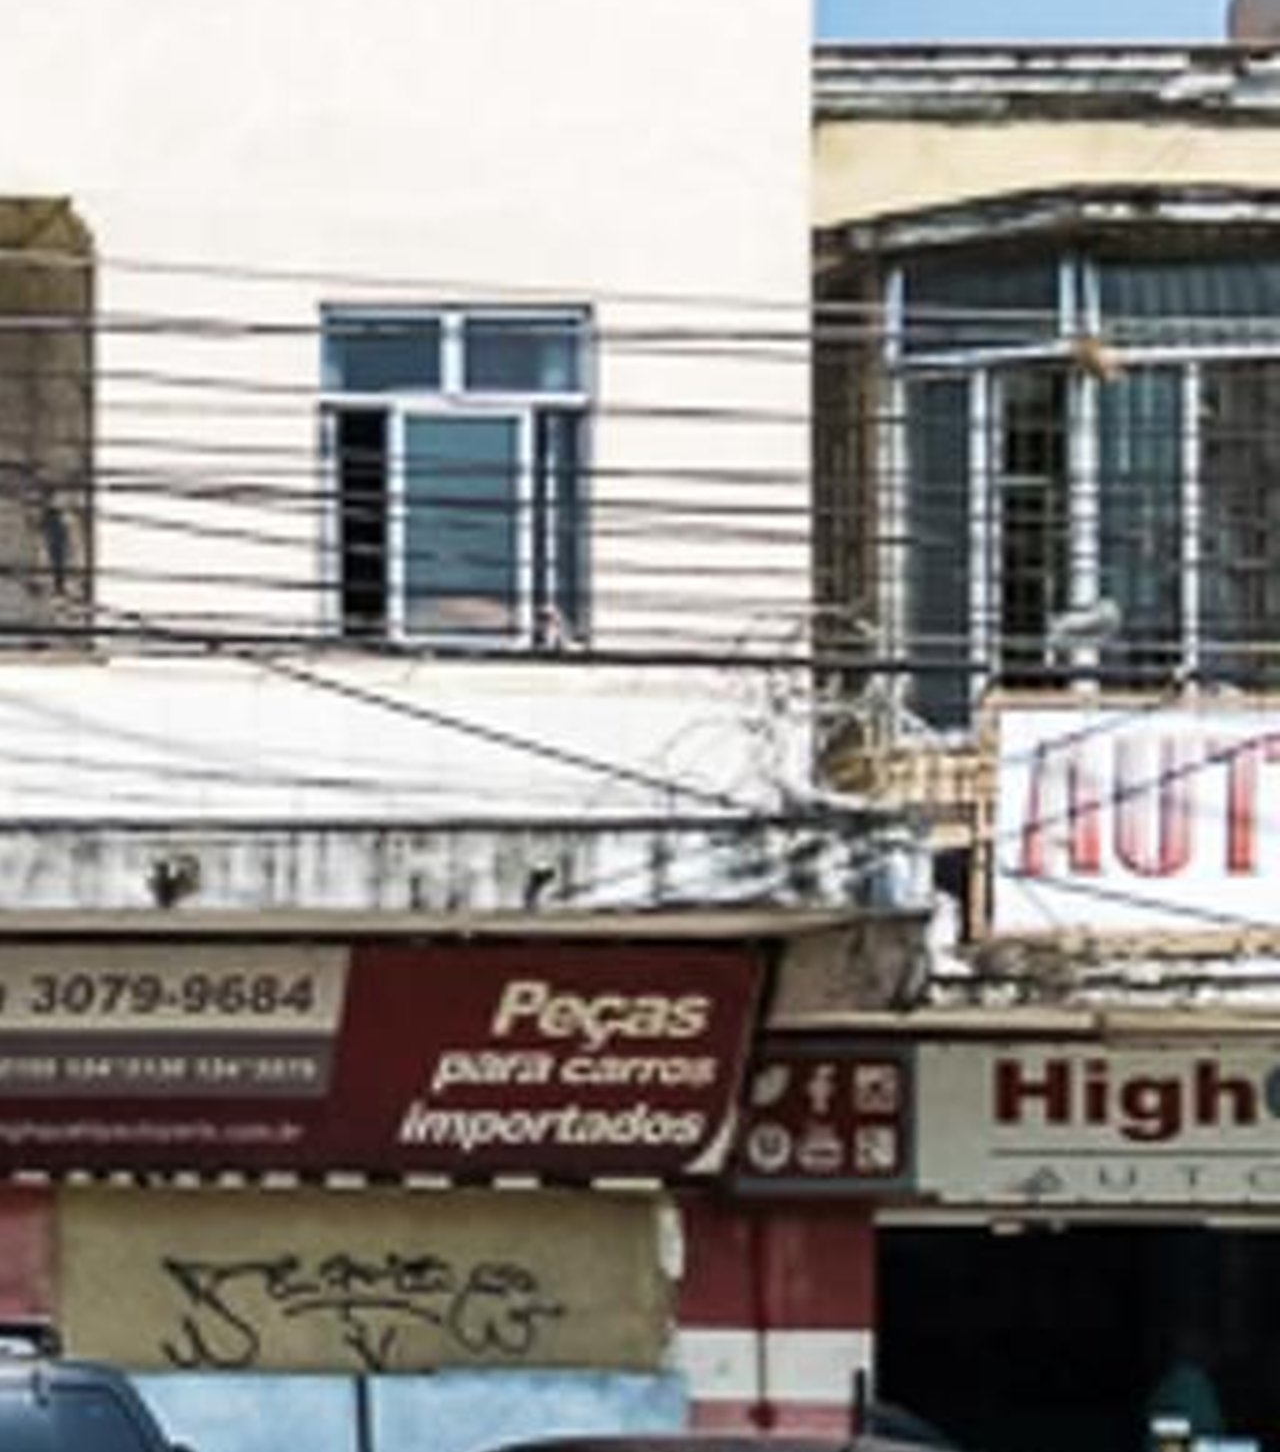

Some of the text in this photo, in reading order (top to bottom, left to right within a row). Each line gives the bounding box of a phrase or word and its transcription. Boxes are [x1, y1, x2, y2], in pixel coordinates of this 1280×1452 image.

[32, 973, 314, 1015] 3079-9684
[493, 980, 711, 1051] Peças
[431, 1051, 717, 1092] para carros
[399, 1100, 706, 1151] importados
[995, 1058, 1280, 1142] High
